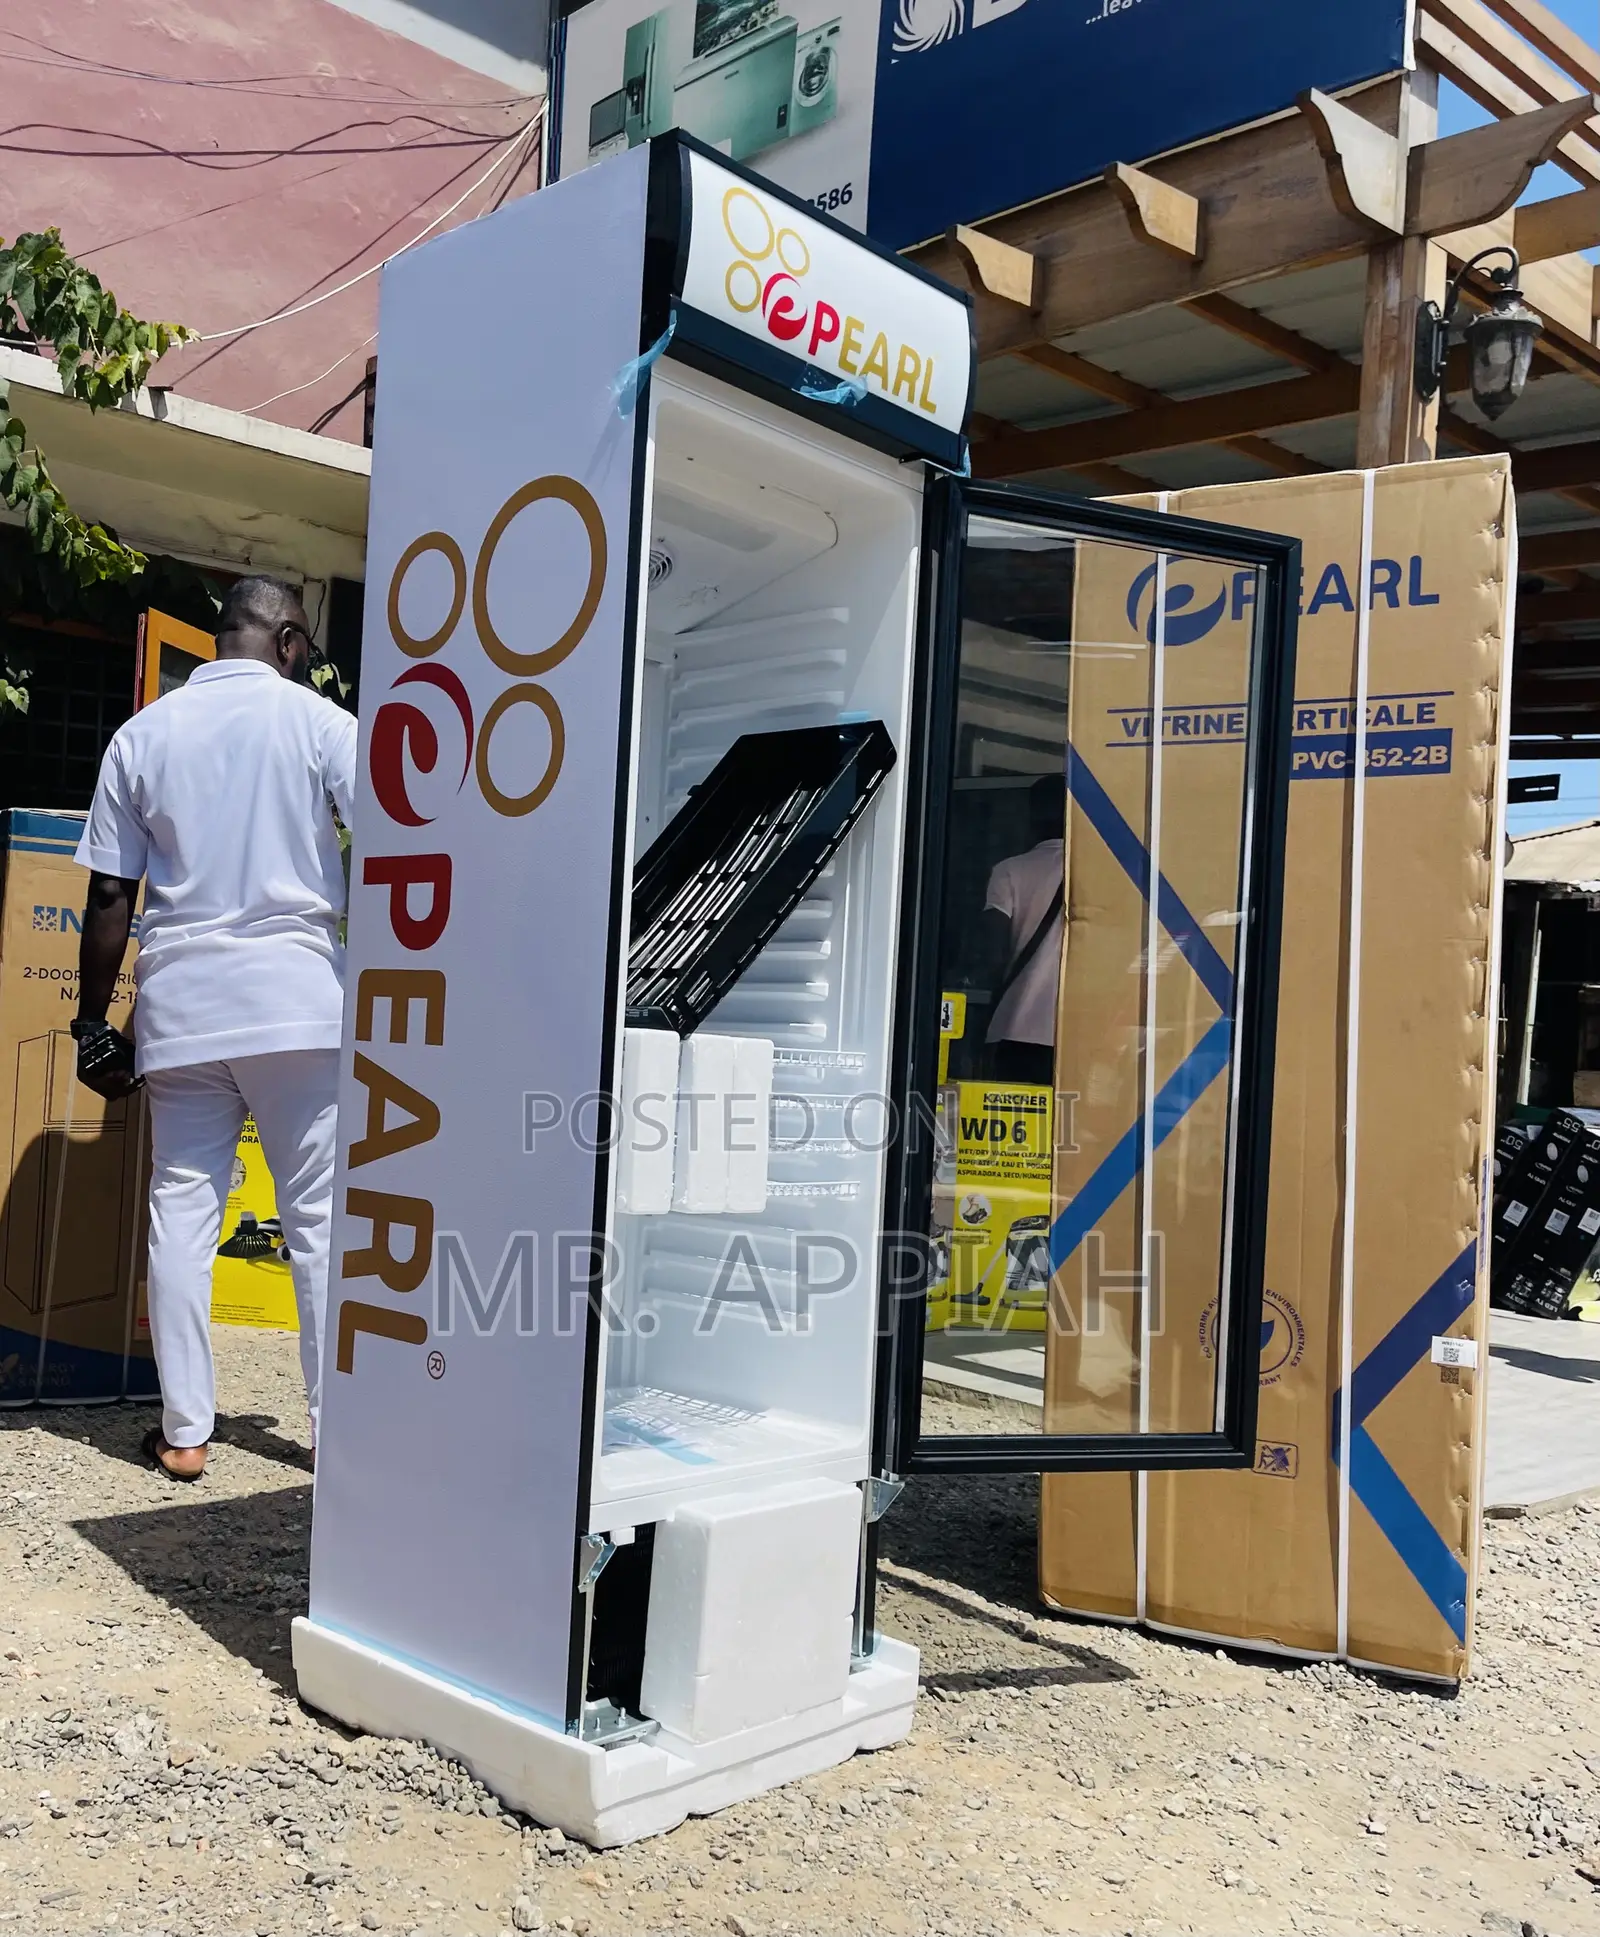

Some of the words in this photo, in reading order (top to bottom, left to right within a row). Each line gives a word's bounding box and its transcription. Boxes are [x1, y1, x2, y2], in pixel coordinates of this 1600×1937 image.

[806, 182, 853, 212] 586
[808, 299, 938, 415] PEARL
[1231, 555, 1440, 621] PARL
[1293, 702, 1437, 732] RTICALE
[336, 853, 453, 1375] PEARL
[961, 1117, 1007, 1142] WD
[1012, 1120, 1027, 1144] 6
